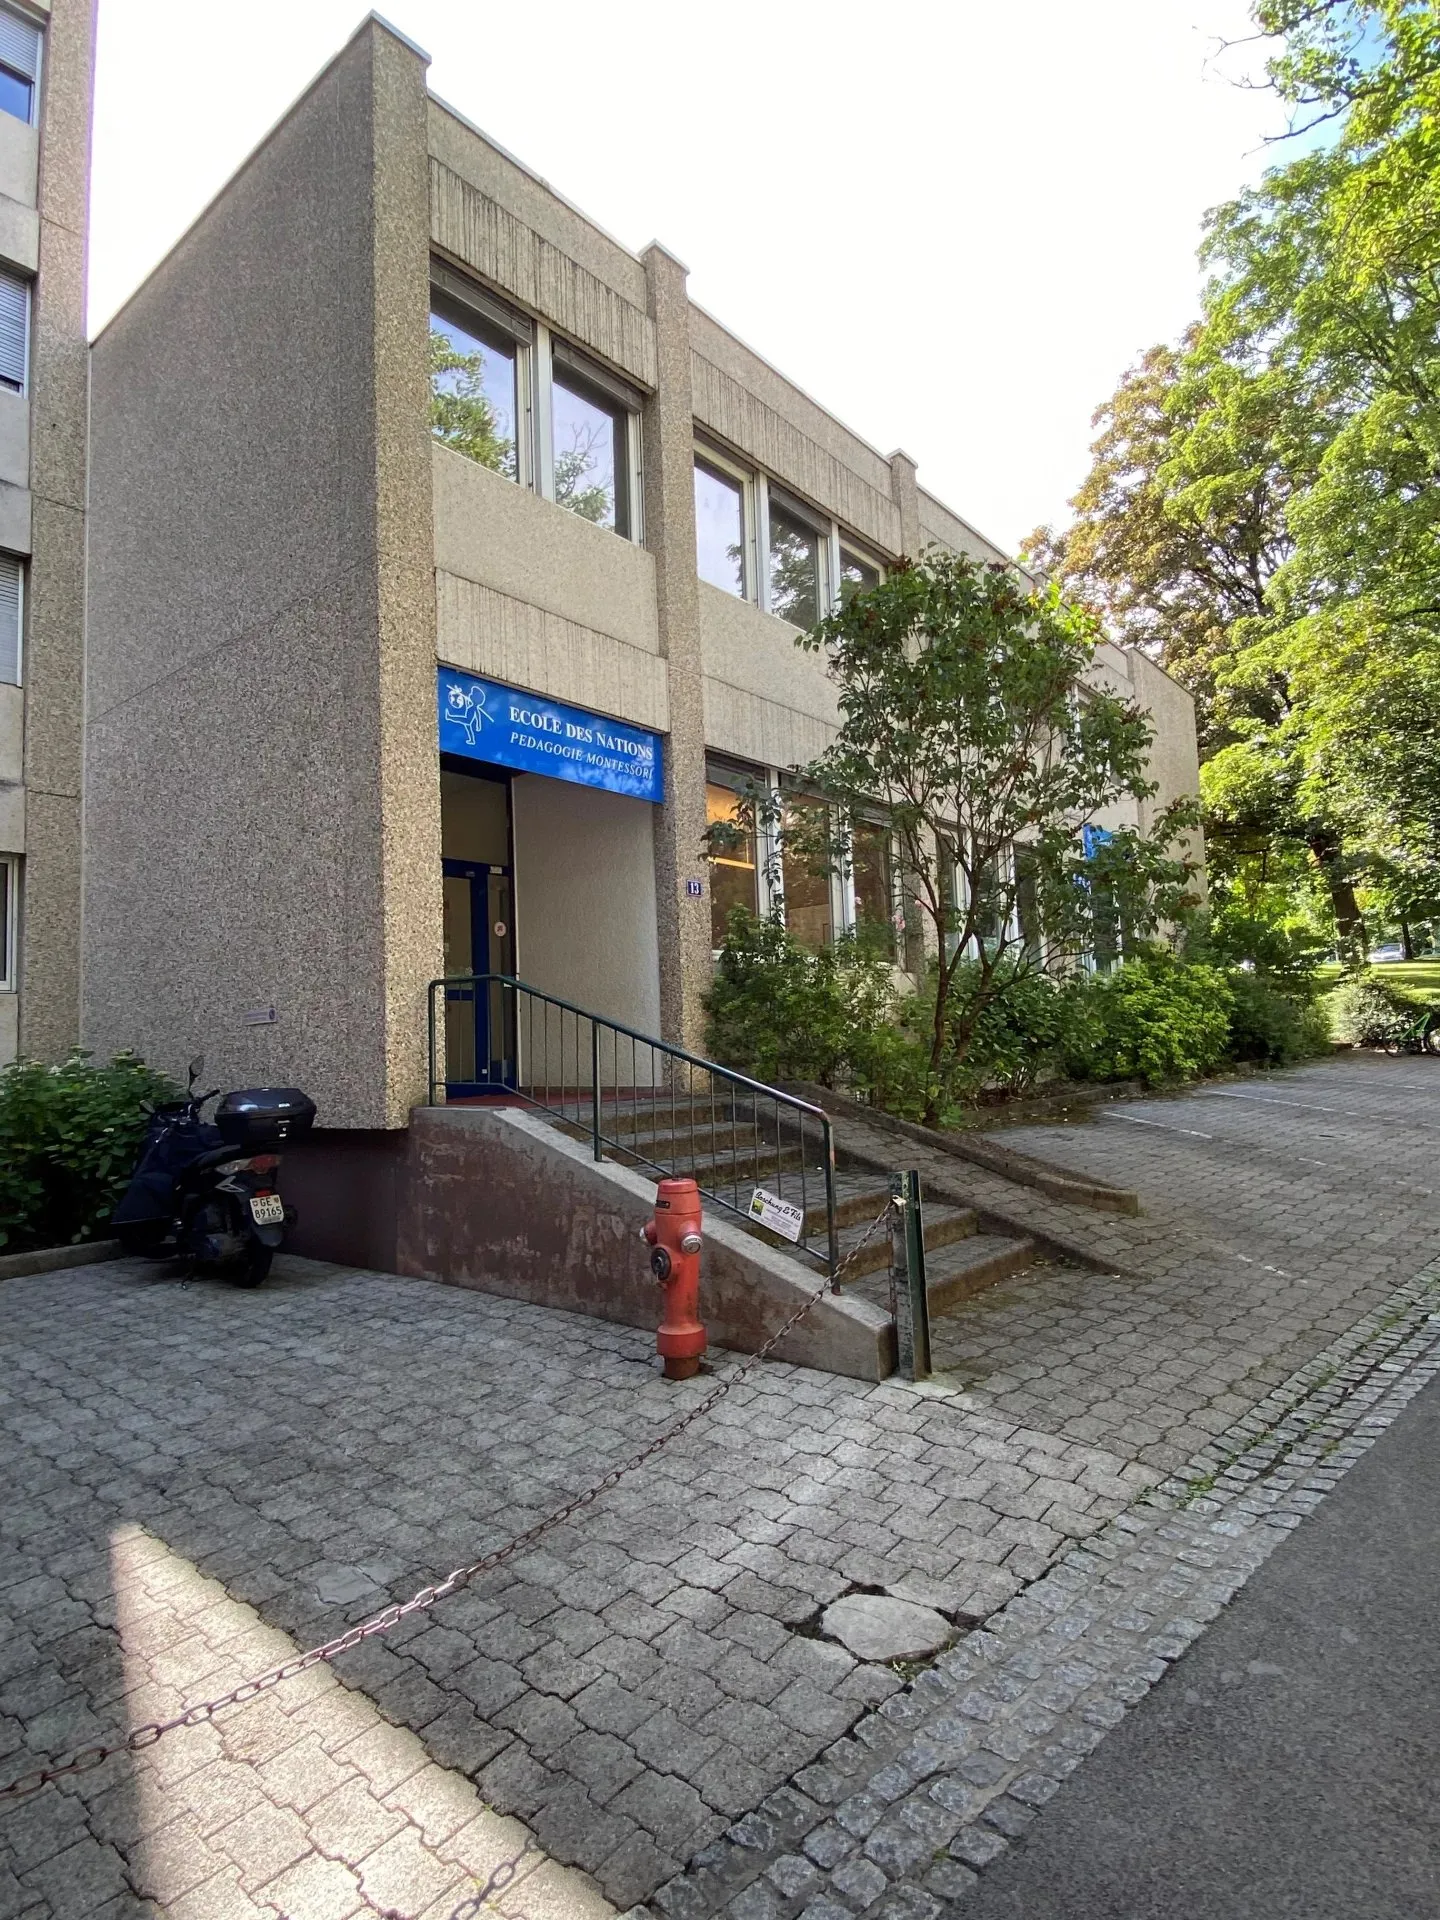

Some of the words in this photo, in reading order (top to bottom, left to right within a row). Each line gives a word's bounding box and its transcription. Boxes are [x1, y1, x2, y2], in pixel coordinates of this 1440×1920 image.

[509, 706, 562, 735] ECOLE
[566, 723, 593, 744] DES
[596, 731, 653, 760] NATIONS
[510, 731, 583, 761] PEDAGOGIE
[586, 752, 654, 780] MONTESSORI
[690, 882, 699, 894] 13
[260, 1197, 273, 1207] GE
[254, 1206, 282, 1219] 89165
[790, 1208, 801, 1221] Fils
